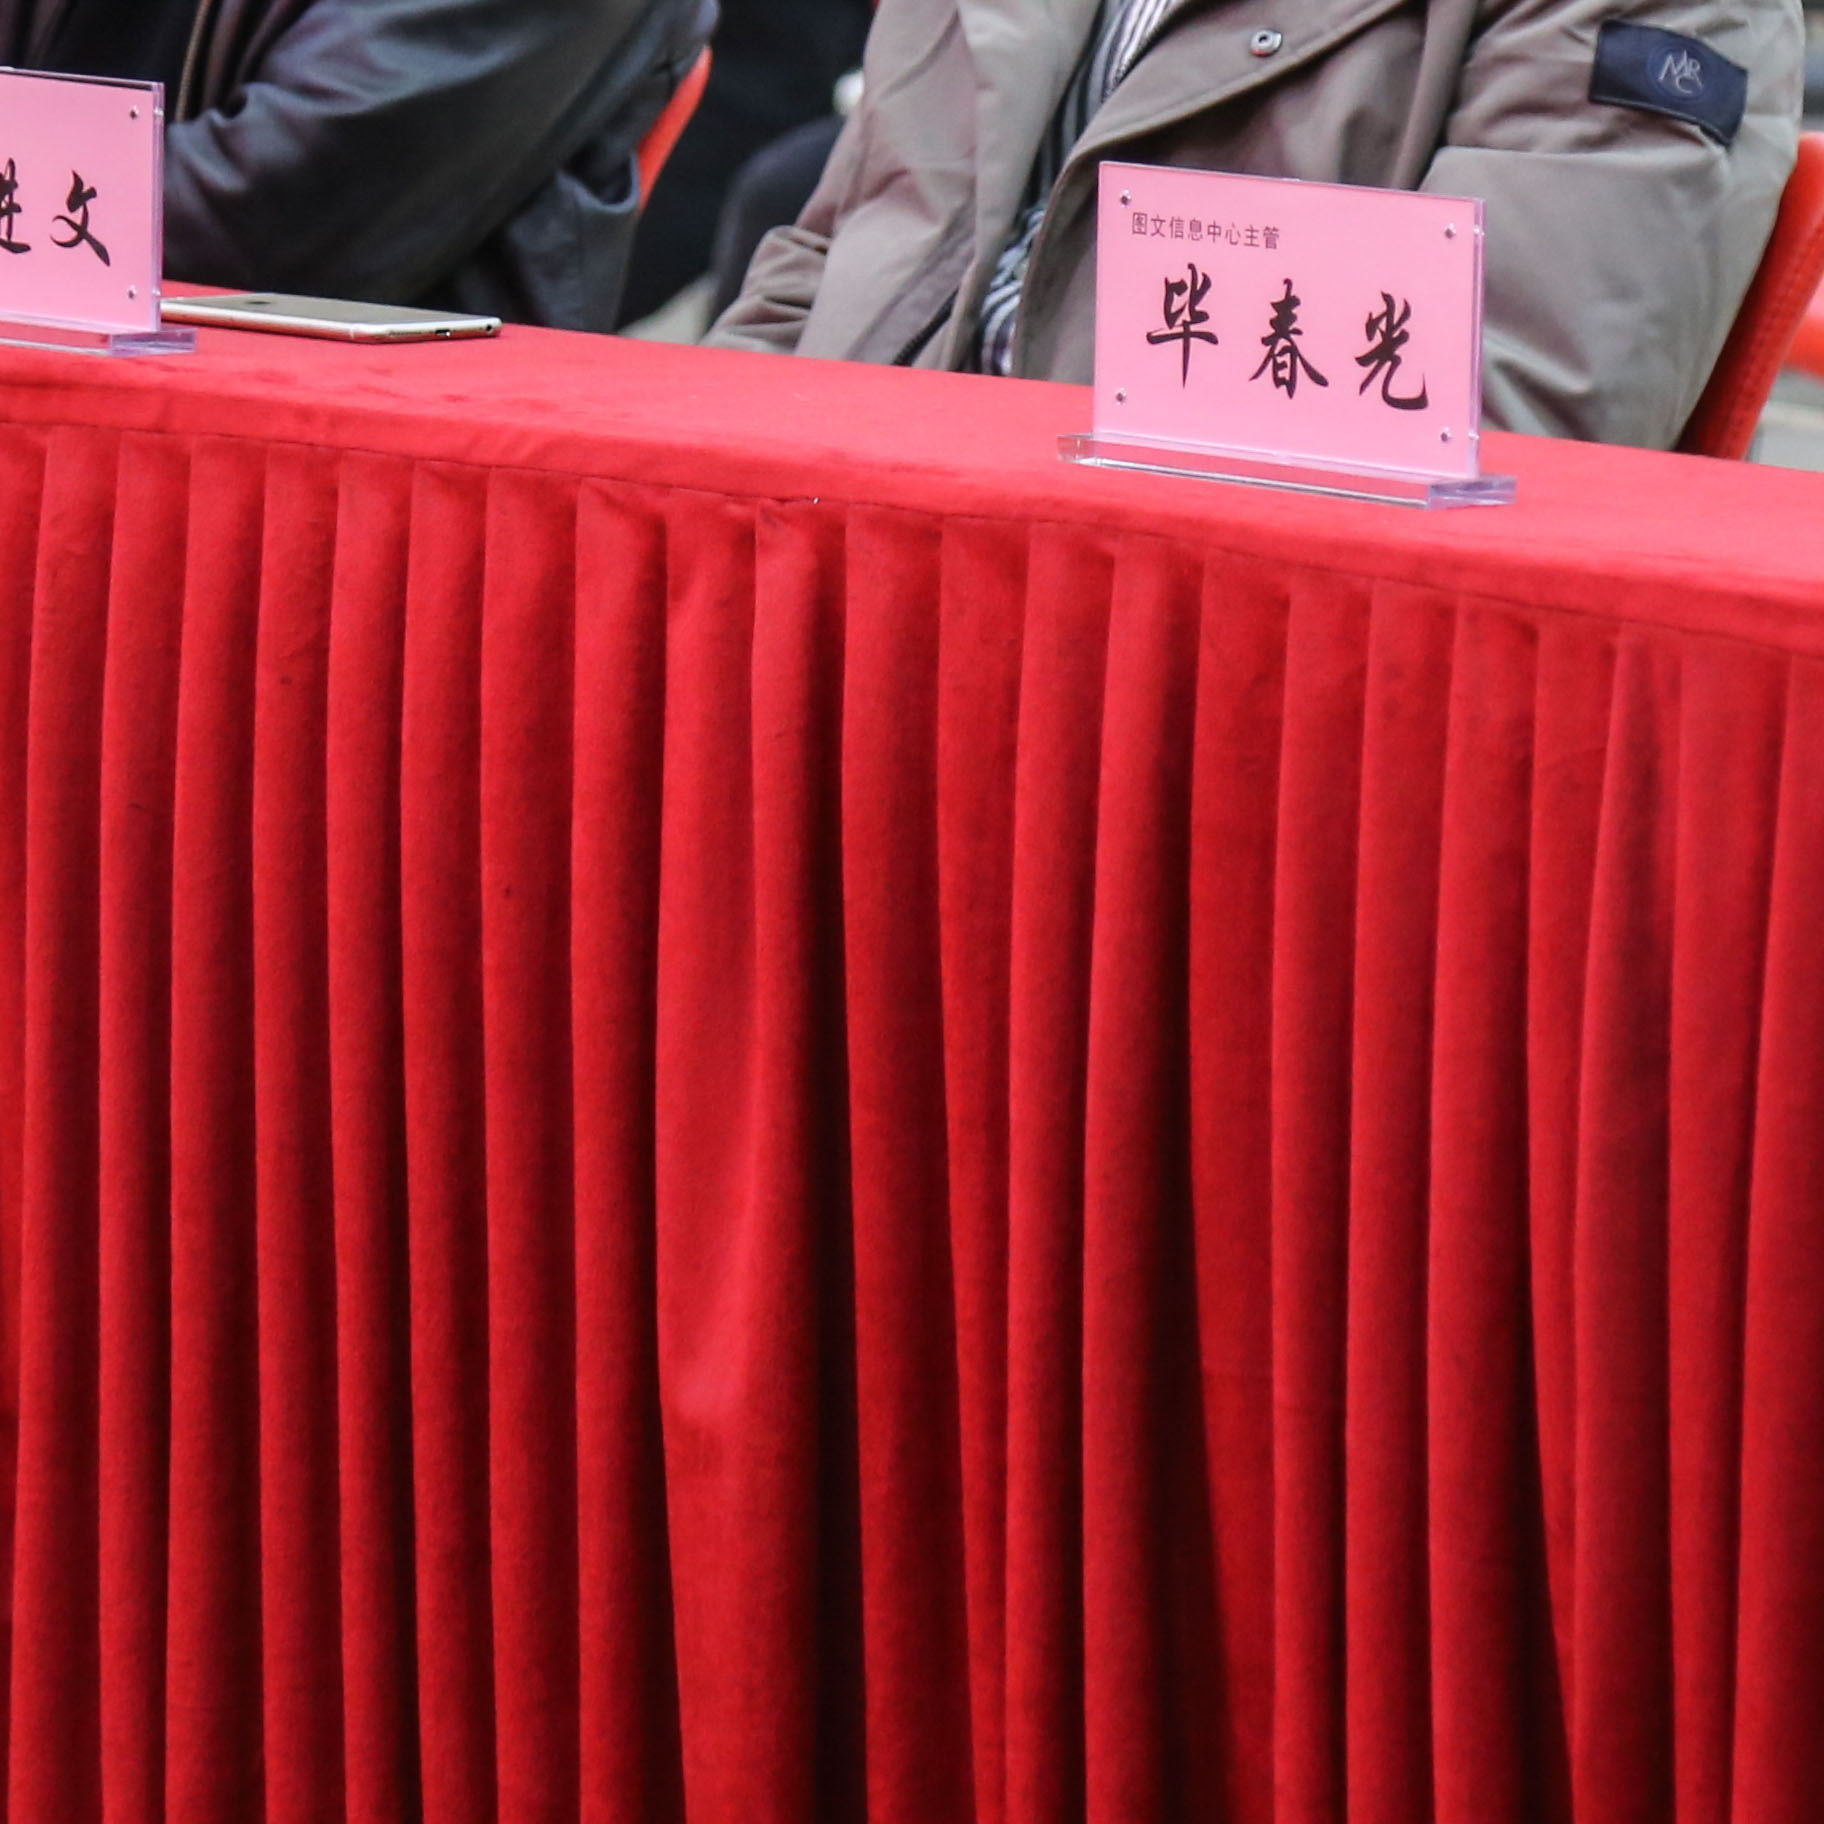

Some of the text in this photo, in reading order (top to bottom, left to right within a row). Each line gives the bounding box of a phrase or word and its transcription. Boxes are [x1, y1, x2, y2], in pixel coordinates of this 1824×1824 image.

[1130, 210, 1282, 251] 图文信息中心主管
[1145, 261, 1431, 412] 毕春光
